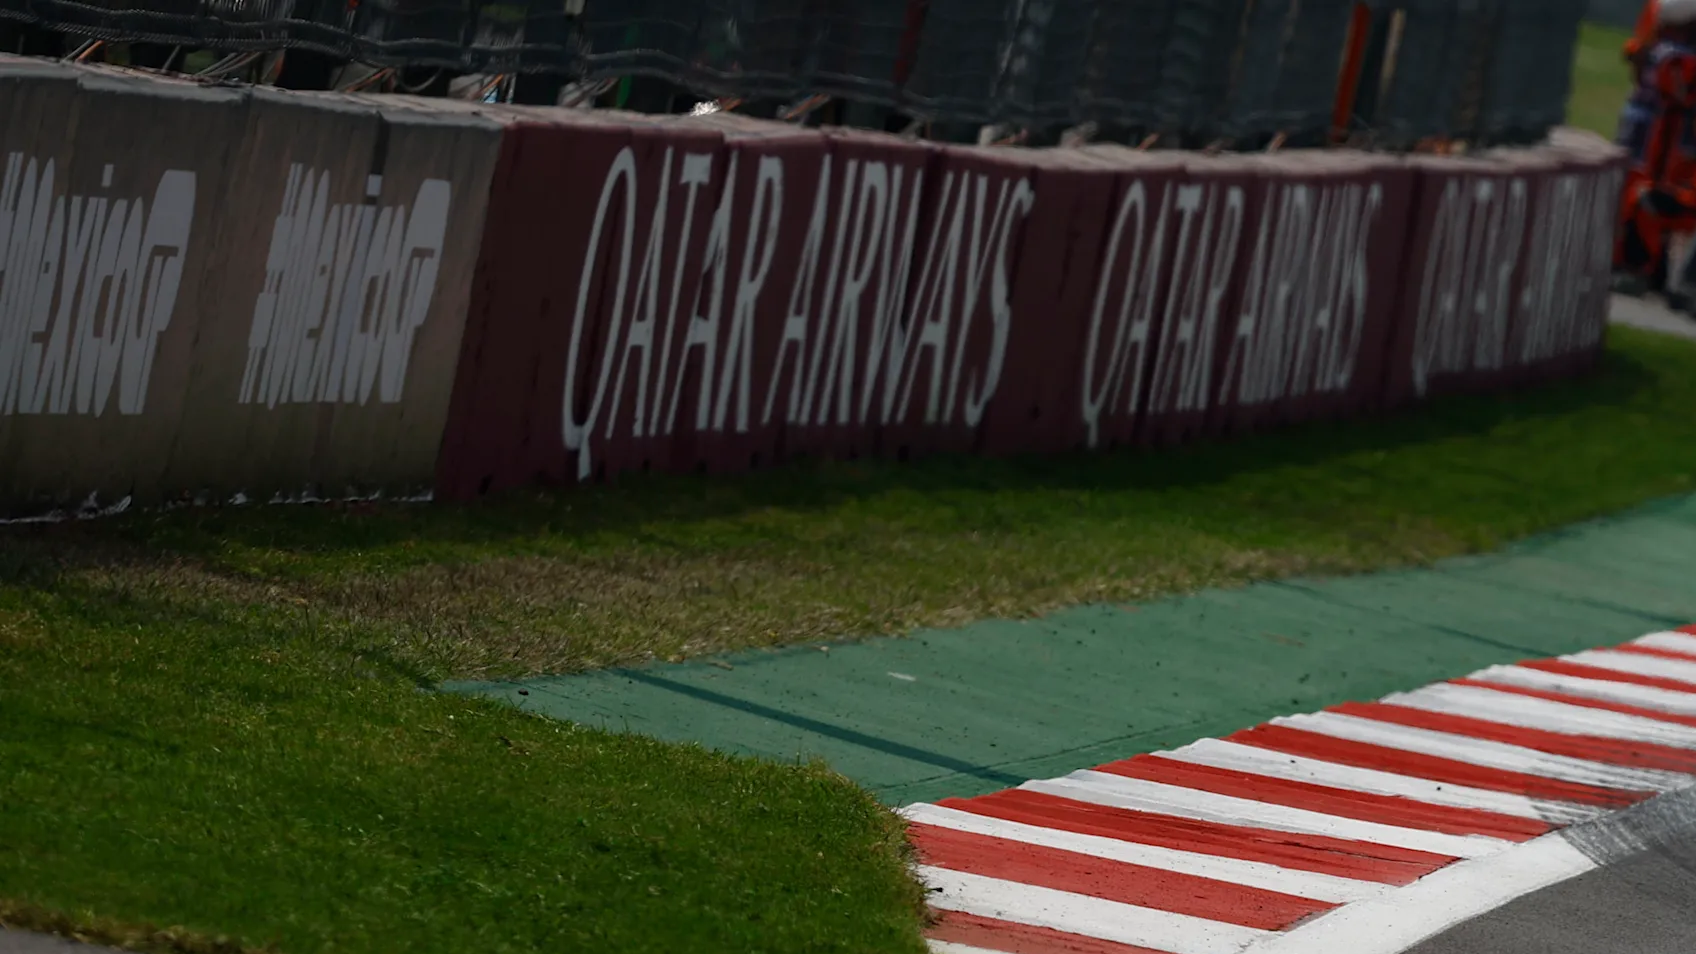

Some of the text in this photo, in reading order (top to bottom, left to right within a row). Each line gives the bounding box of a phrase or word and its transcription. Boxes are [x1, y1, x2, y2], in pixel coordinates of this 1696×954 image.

[562, 146, 1034, 481] QATAR AIRWAYS
[1082, 178, 1243, 449] QATAR
